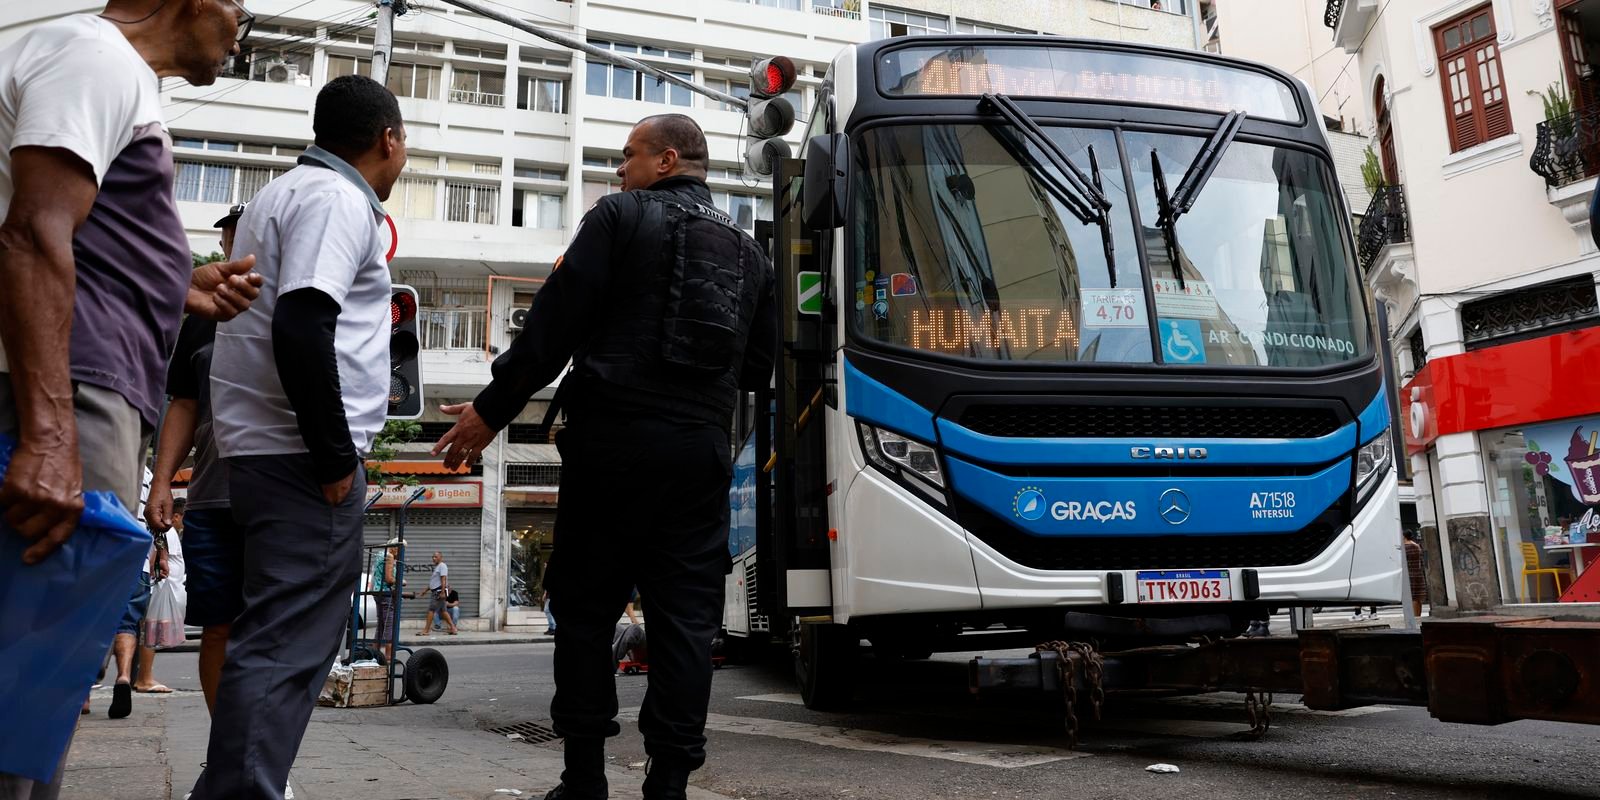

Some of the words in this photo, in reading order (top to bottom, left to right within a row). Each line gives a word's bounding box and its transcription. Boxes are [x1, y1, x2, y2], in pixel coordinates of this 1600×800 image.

[921, 59, 1006, 96] 409
[1080, 70, 1222, 98] BOTAFOGO
[1096, 304, 1135, 322] 4,70
[912, 308, 1080, 349] HUMAITA
[1208, 329, 1231, 345] AR
[1130, 446, 1208, 459] CAIO
[1249, 491, 1296, 509] A71518
[1050, 500, 1137, 523] GRAÇAS
[1252, 509, 1294, 519] INTERSUL
[1145, 580, 1222, 600] TTK9D63
